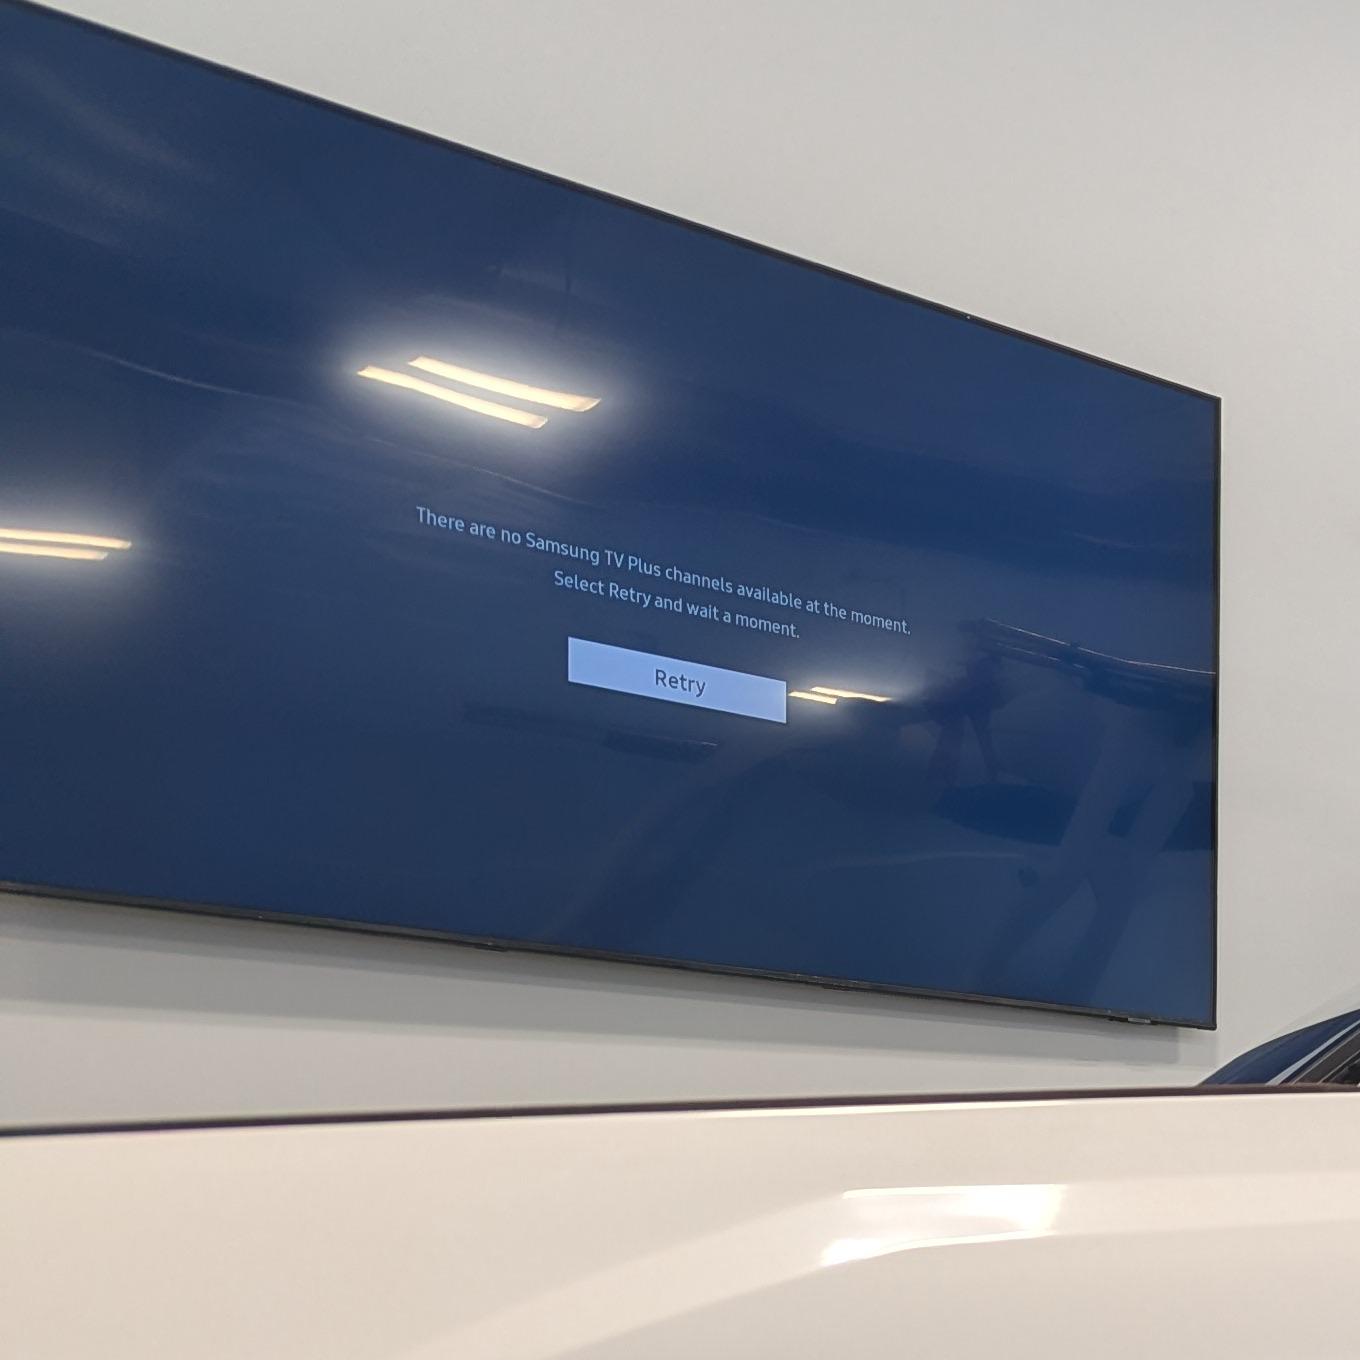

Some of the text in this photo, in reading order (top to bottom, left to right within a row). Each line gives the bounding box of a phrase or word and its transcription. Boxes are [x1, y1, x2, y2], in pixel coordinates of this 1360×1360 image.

[415, 506, 911, 635] There are no Samsung TV Plus channels available at the moment.
[554, 571, 801, 639] Select Retry and wait a moment.
[655, 668, 706, 698] Retry
